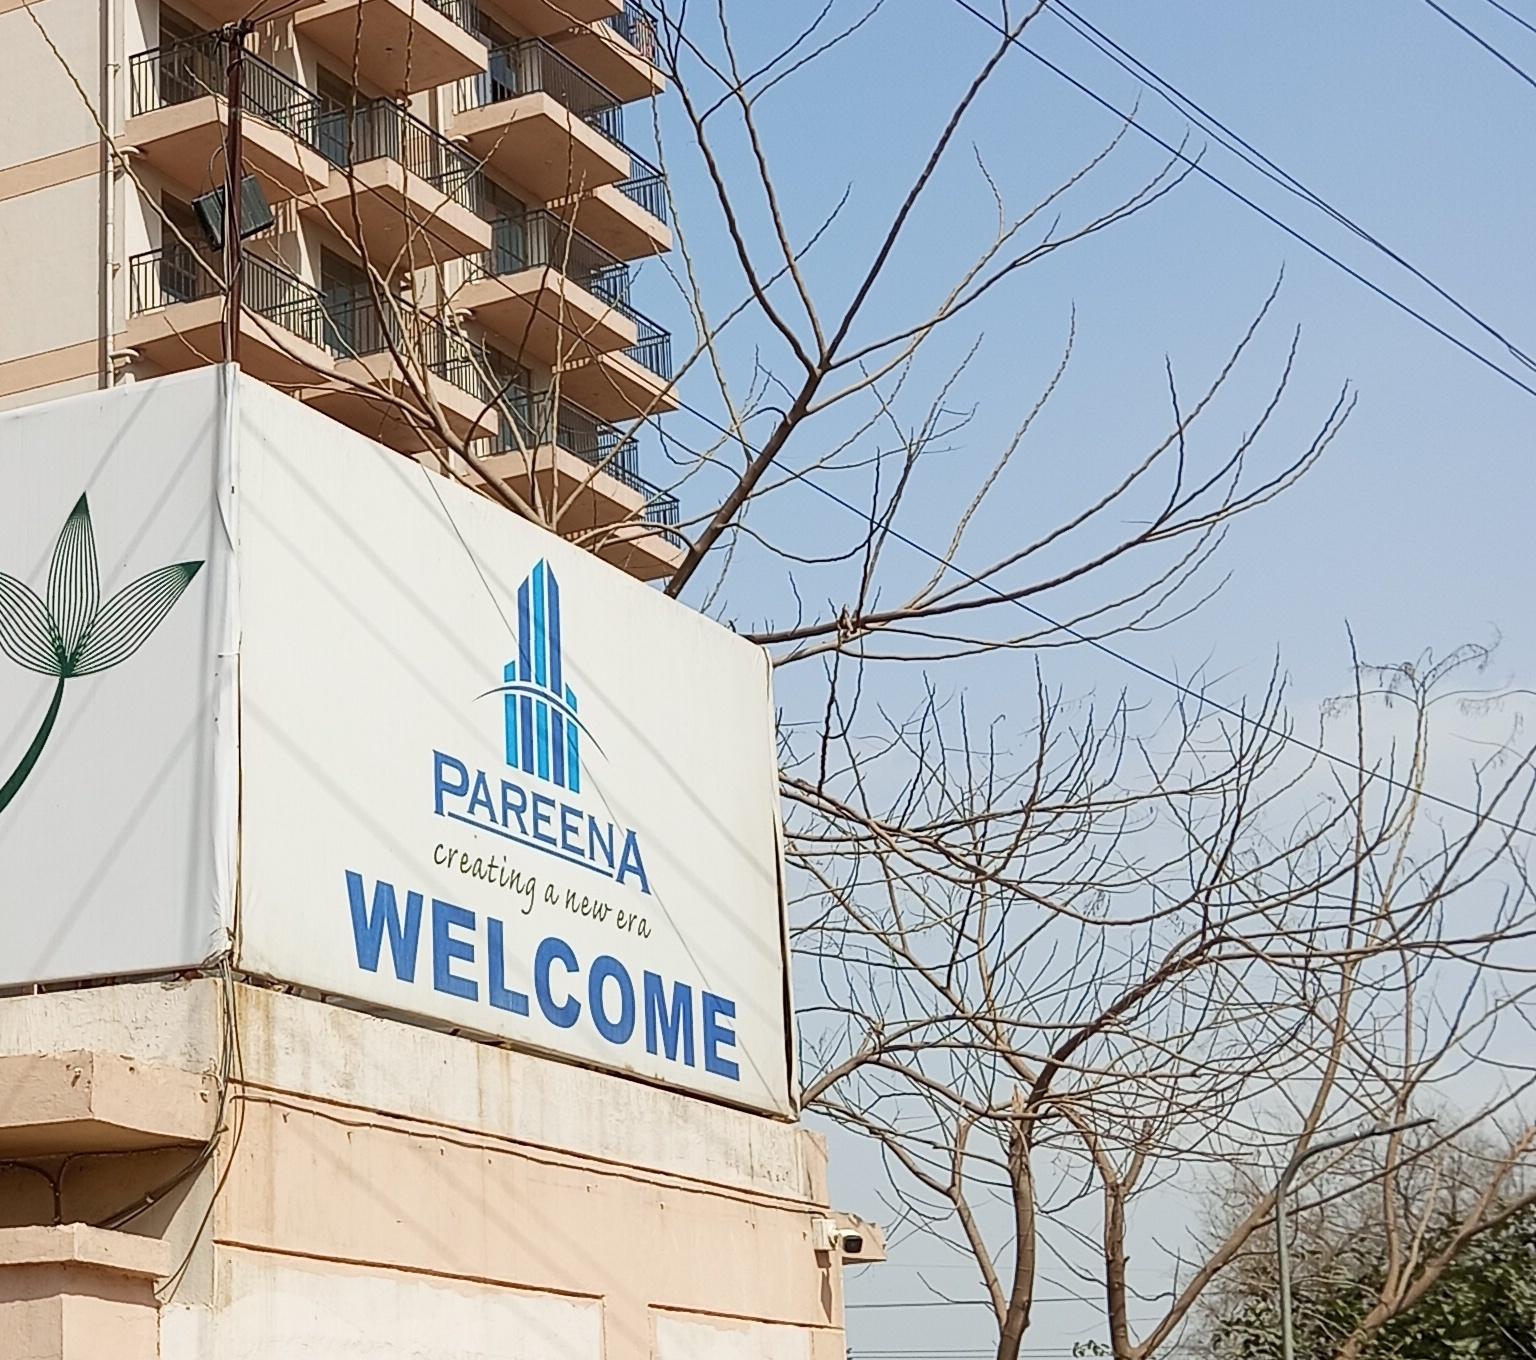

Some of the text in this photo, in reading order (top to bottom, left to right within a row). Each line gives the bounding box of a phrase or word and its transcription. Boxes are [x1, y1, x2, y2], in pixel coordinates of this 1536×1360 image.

[432, 749, 652, 895] PAREENA
[433, 843, 652, 939] creating a new era
[345, 870, 740, 1081] WELCOME
